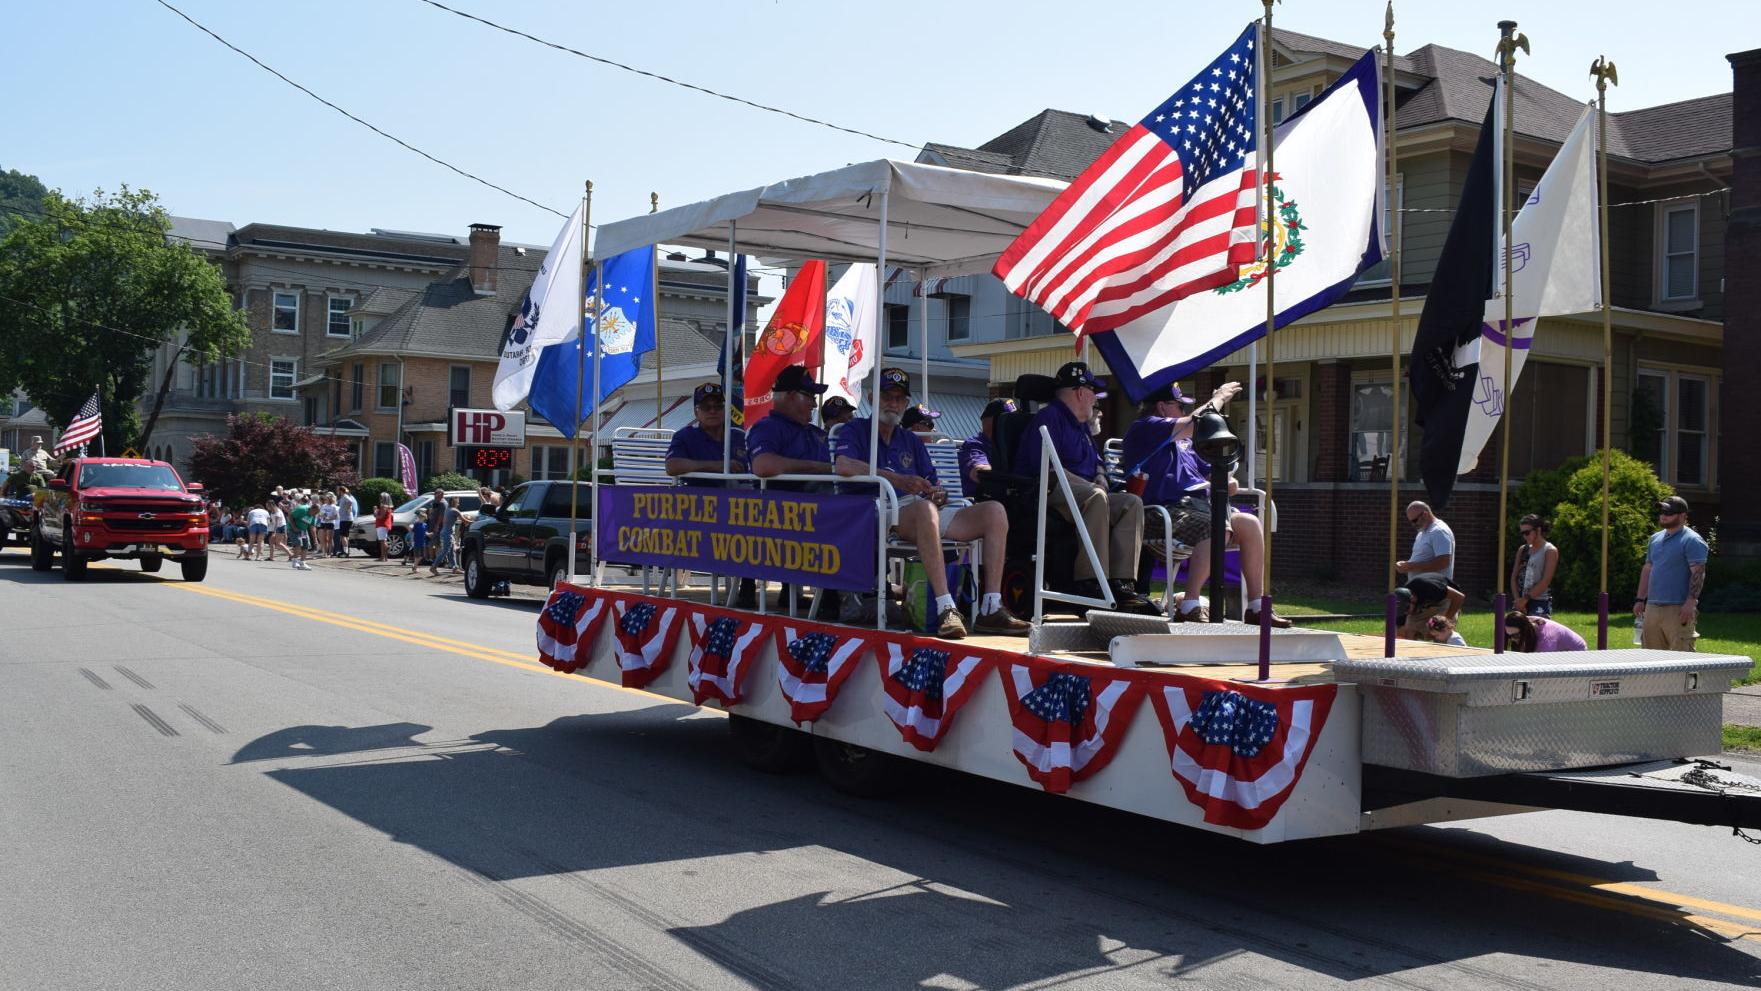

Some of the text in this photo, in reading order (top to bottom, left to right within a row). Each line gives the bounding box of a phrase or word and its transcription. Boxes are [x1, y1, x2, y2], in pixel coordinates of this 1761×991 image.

[633, 493, 818, 532] PURPLE HEART
[618, 526, 841, 575] COMBAT WOUNDED
